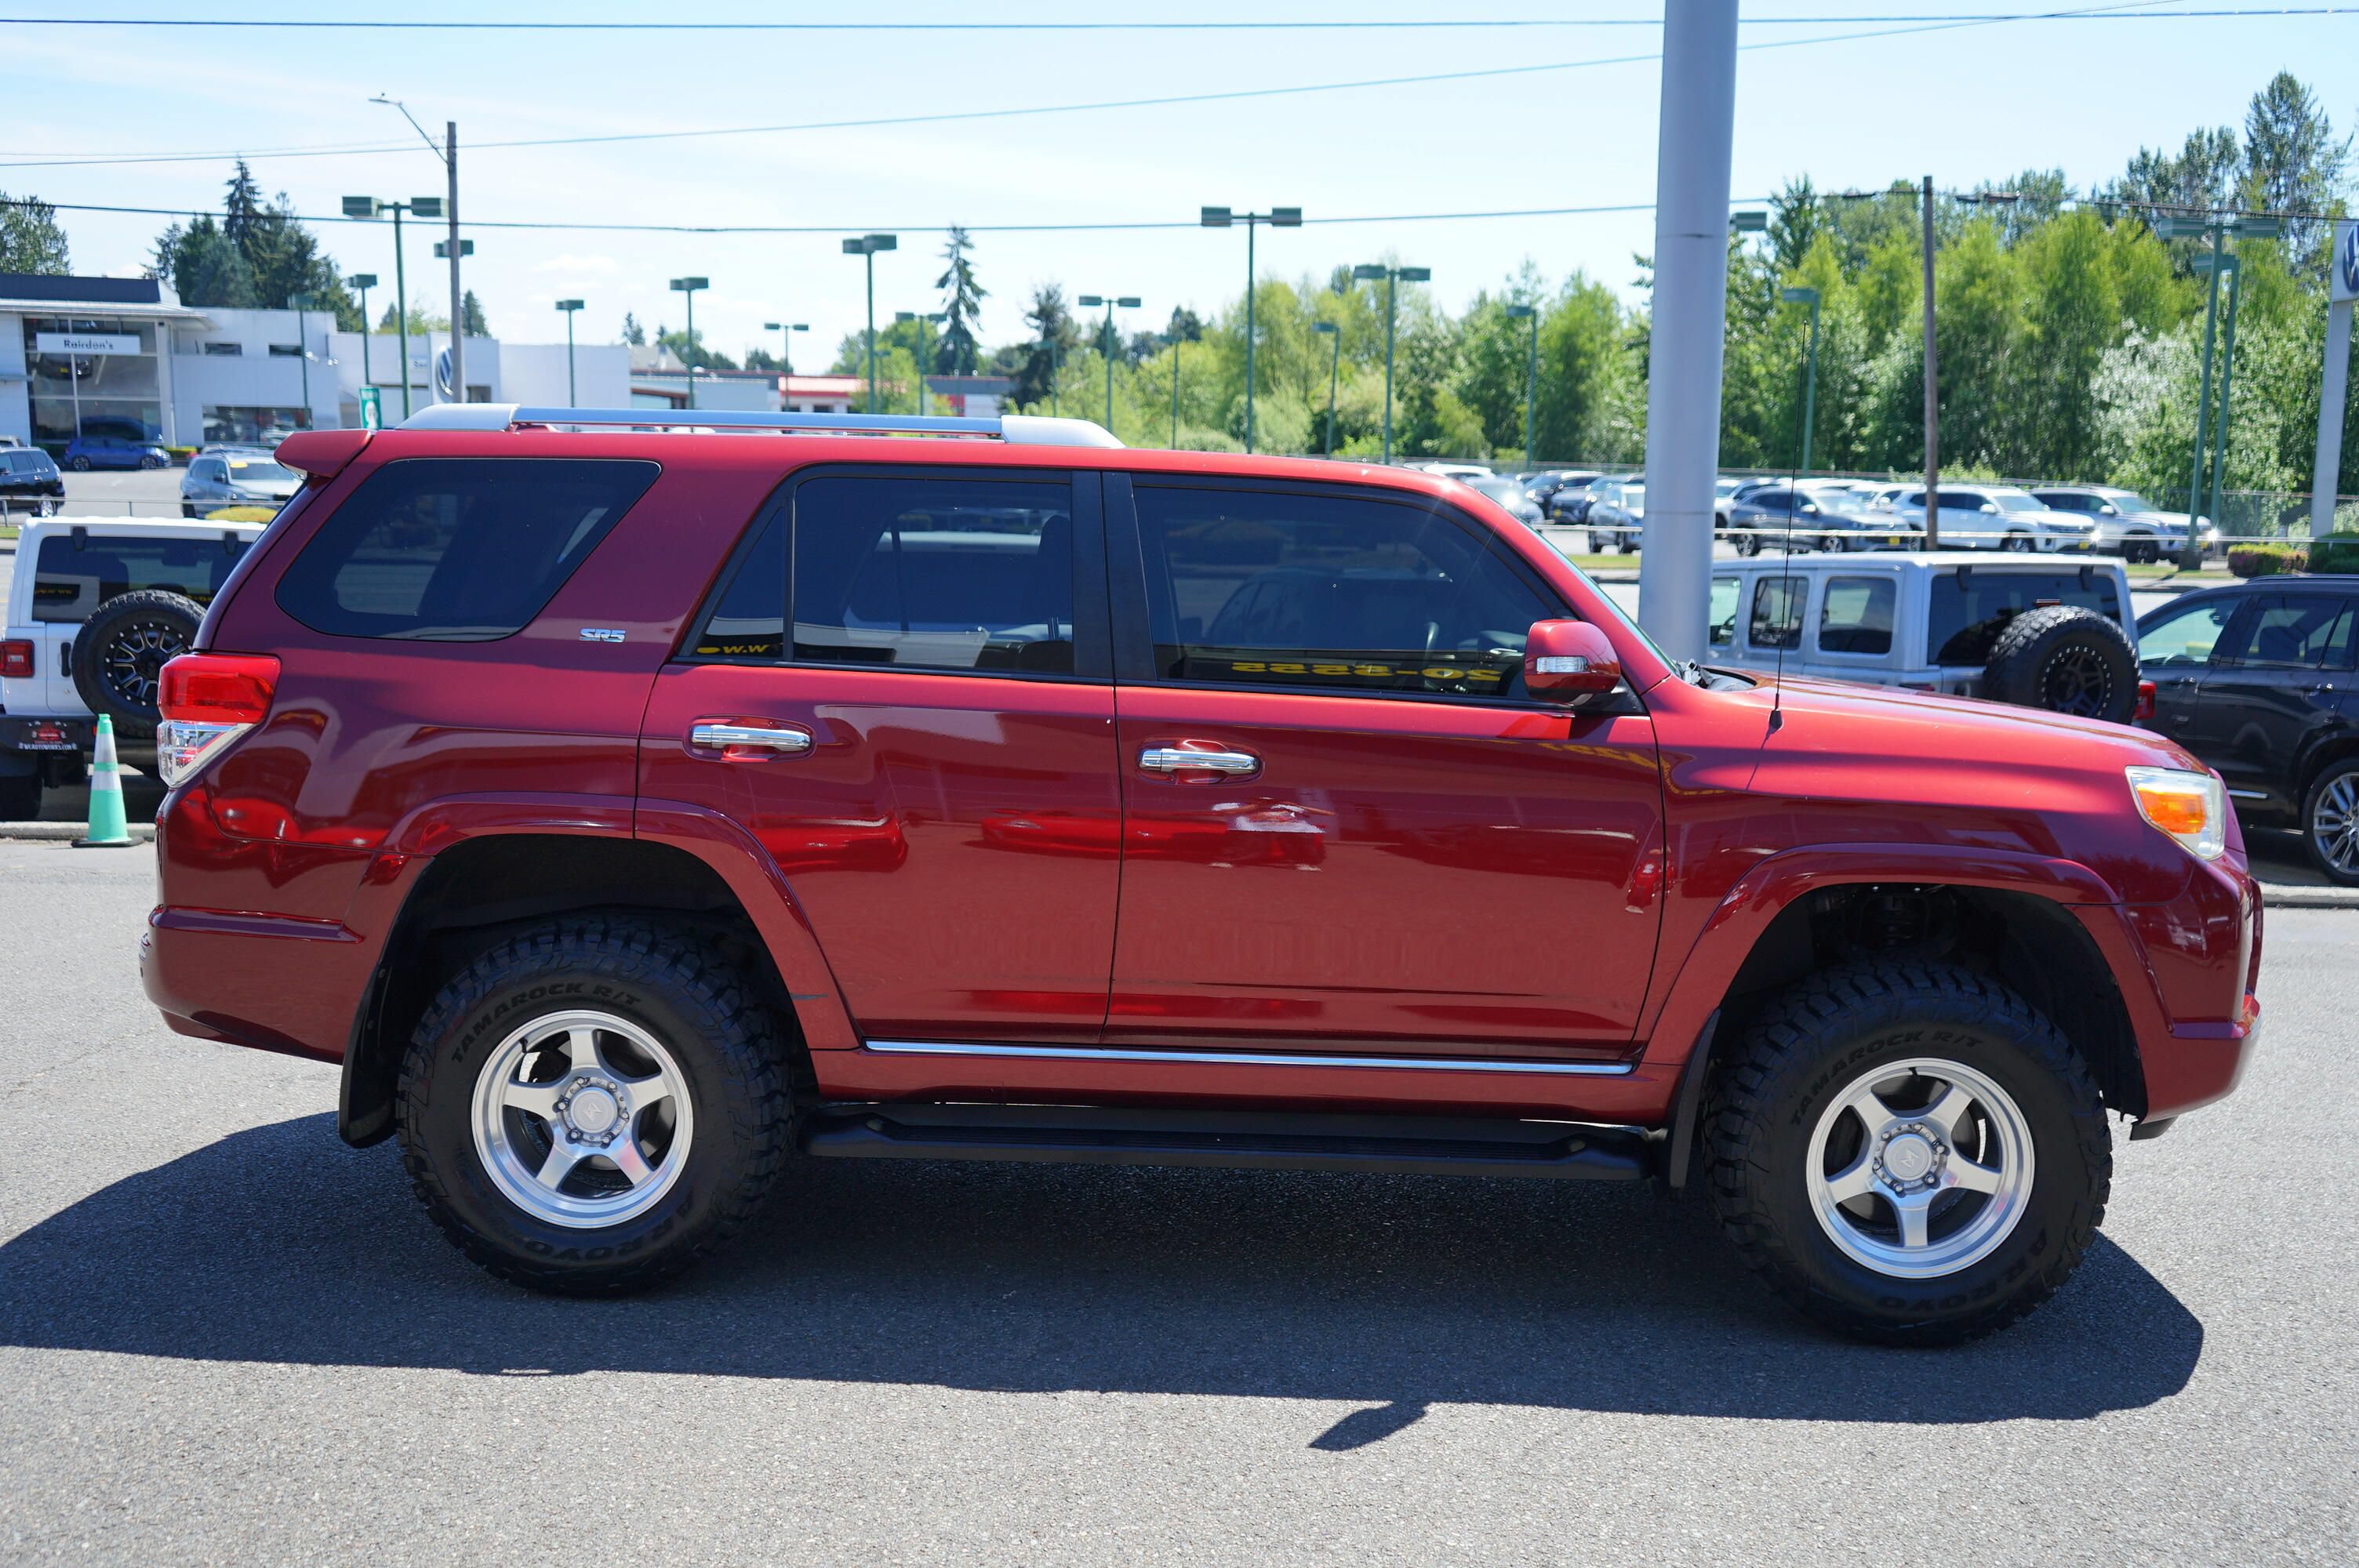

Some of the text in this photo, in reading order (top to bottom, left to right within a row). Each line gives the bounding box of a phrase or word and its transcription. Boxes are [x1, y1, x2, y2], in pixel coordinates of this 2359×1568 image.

[64, 339, 114, 350] Rairdon's
[580, 628, 626, 643] SR5
[451, 982, 642, 1063] TAMAROCK R/T
[1790, 1029, 1983, 1126] TAMAROCK R/T
